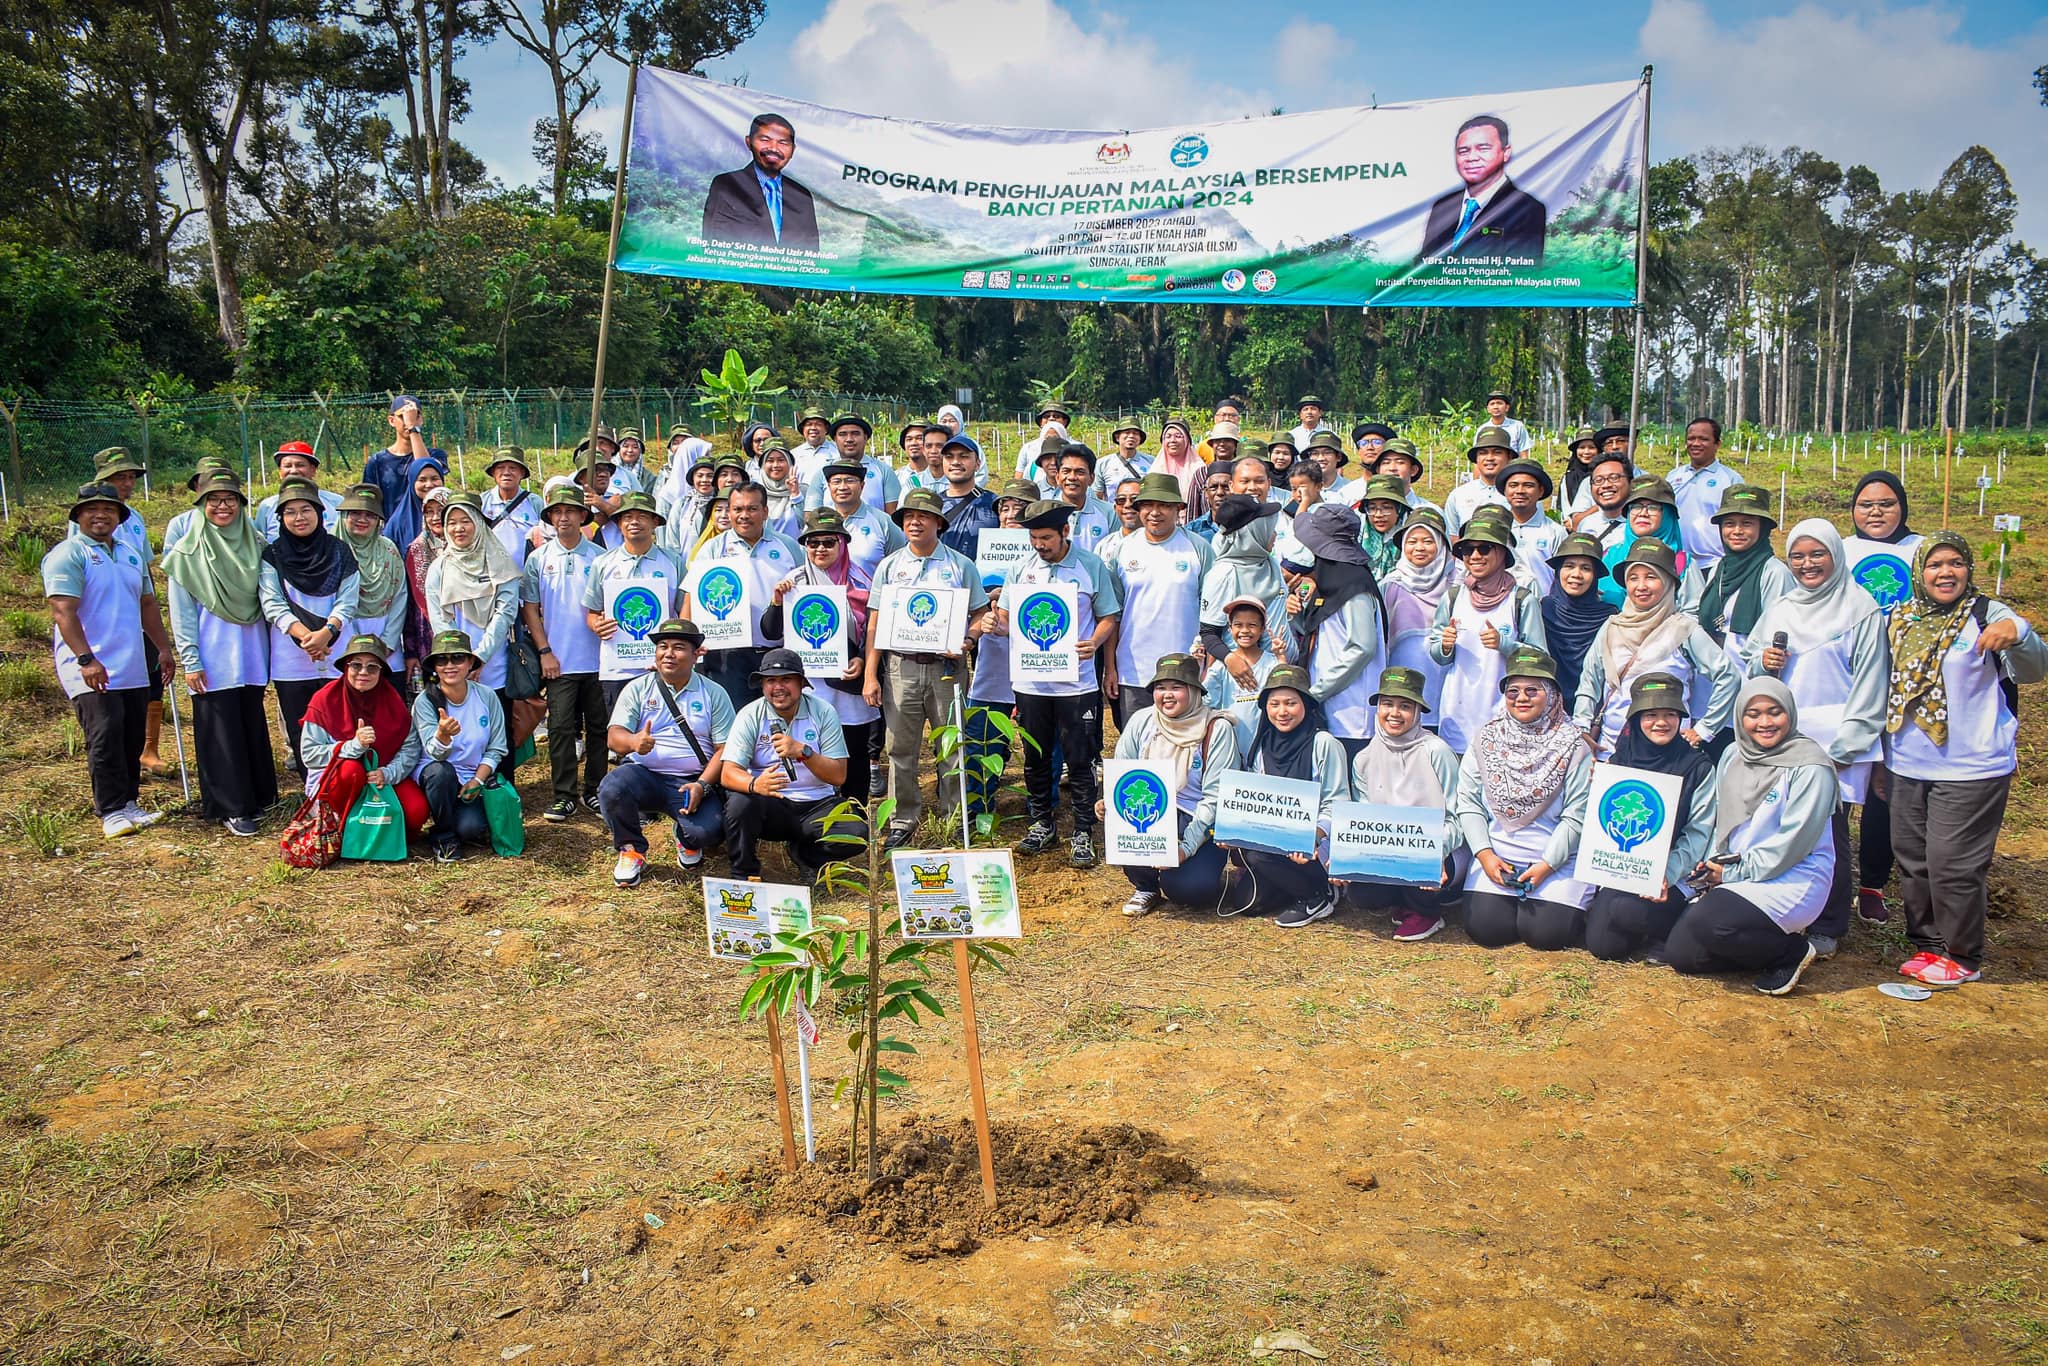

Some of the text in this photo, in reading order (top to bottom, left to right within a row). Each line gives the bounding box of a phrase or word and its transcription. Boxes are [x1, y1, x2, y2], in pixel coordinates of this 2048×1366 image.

[841, 161, 1408, 199] PROGRAM PENGHIJAUAN MALAYSIA BERSEMPENA
[987, 191, 1254, 217] BANCI PERTANIAN 2024
[1074, 222, 1084, 230] 17
[1086, 218, 1134, 231] DISEMBER
[1082, 233, 1103, 243] PAGI
[1145, 229, 1182, 240] TENGAH
[1184, 229, 1207, 239] HARI
[734, 242, 747, 251] Sri
[747, 243, 759, 252] Dr.
[760, 245, 786, 255] Mohd
[1024, 240, 1238, 256] INSTITUT LATIHAN STATISTIK MALAYSIA (ILSM)
[703, 247, 726, 257] Ketua
[727, 249, 780, 263] Perangkawan
[1135, 255, 1167, 267] PERAK
[1447, 256, 1460, 265] Dr.
[1461, 255, 1489, 265] Ismail
[1491, 256, 1503, 267] Hj.
[1505, 256, 1535, 266] Parlan
[685, 254, 717, 265] Jabatan
[717, 257, 763, 269] Perangkaan
[764, 262, 798, 273] Malaysia
[1442, 266, 1512, 278] Ketua Pengarah,
[1407, 277, 1462, 289] Penyelidikan
[1463, 277, 1513, 287] Perhutanan
[1514, 277, 1552, 288] Malaysia
[1553, 278, 1581, 288] (FRIM)
[990, 543, 1019, 551] POKOK
[981, 553, 1024, 561] KEHIDUPA
[702, 626, 742, 636] MALAYSIA
[897, 633, 939, 643] MALAYSIA
[617, 648, 656, 656] MALAYSI
[801, 656, 838, 664] ALAYSIA
[1021, 659, 1068, 667] MALAYSIA
[1234, 788, 1301, 808] POKOK KITA
[1223, 799, 1311, 822] KEHIDUPAN KITA
[1350, 820, 1424, 835] POKOK KITA
[1117, 841, 1167, 850] MALAYSIA
[1337, 832, 1436, 850] KEHIDUPAN KITA
[1591, 857, 1651, 876] MALAYSIA
